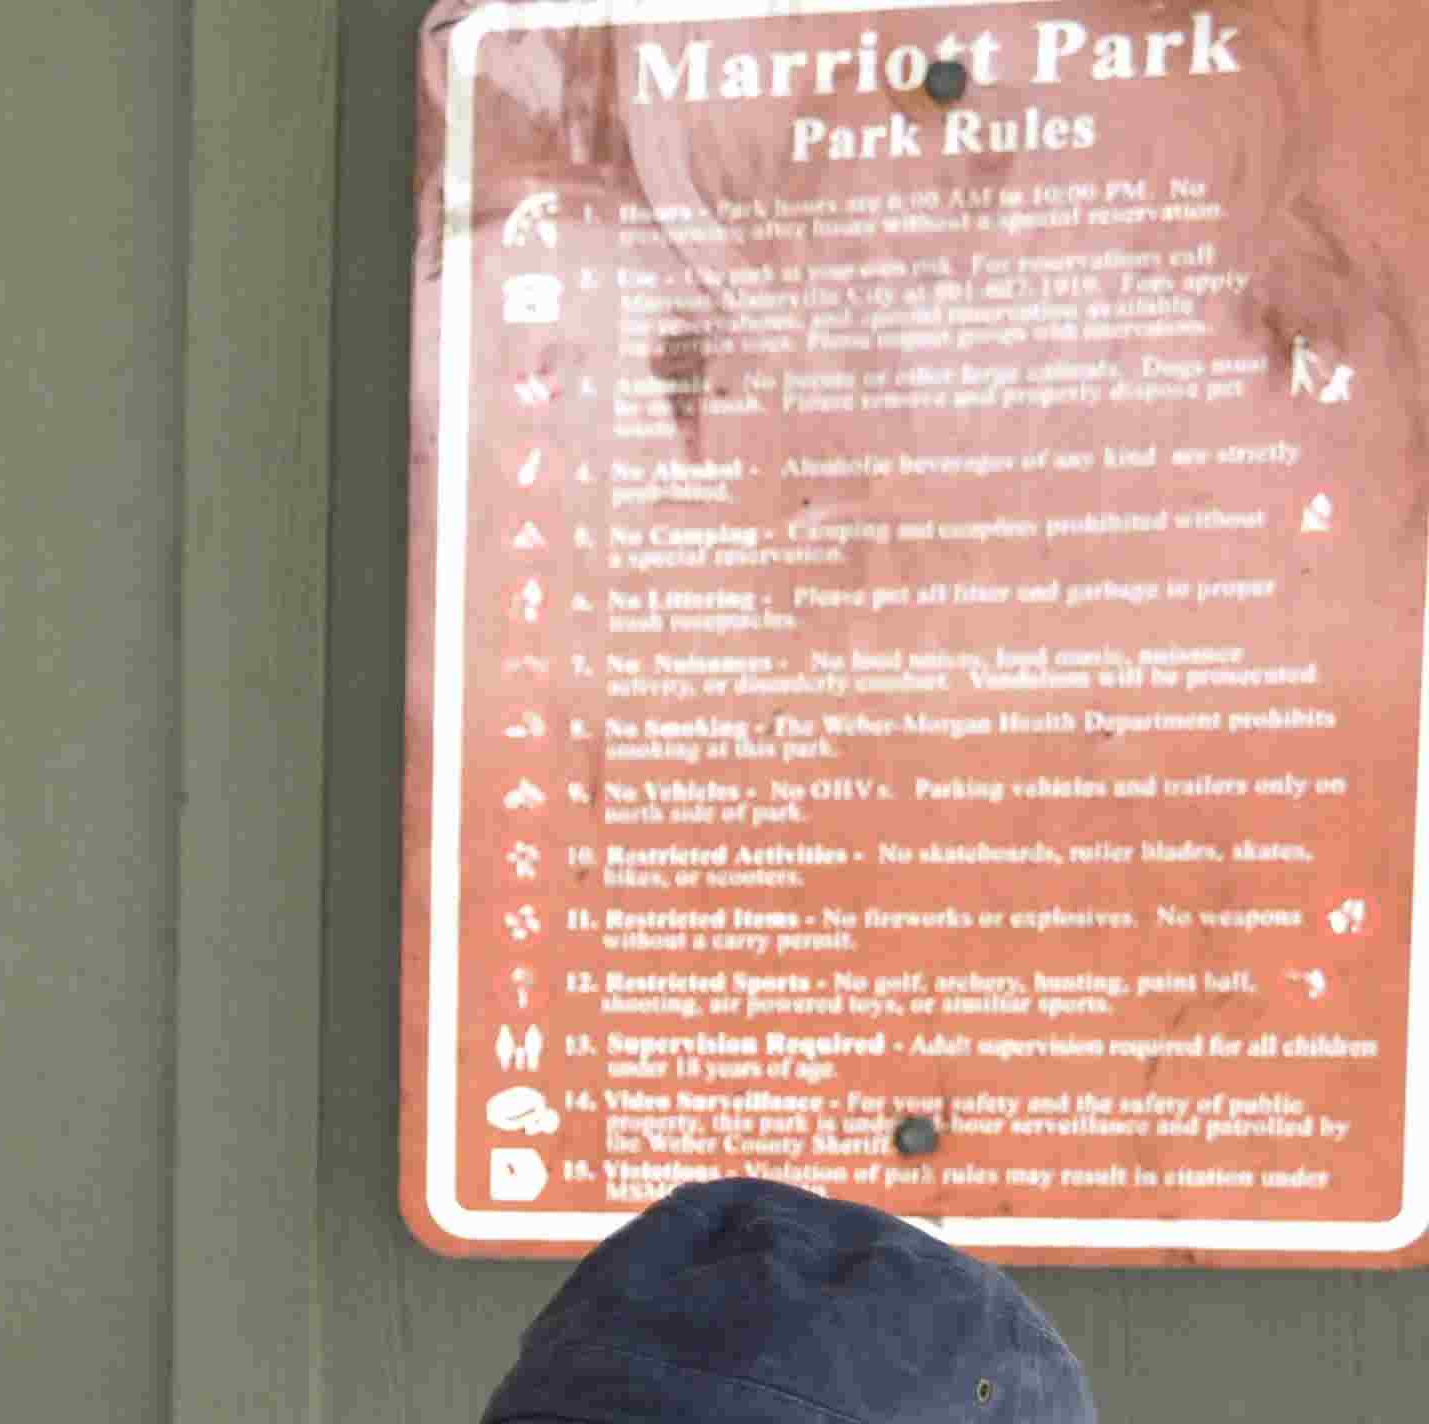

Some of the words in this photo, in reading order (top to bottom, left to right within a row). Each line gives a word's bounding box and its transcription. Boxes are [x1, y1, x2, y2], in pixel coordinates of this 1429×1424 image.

[633, 28, 1003, 104] Marriott
[1029, 12, 1243, 84] Park
[791, 110, 923, 162] Park
[942, 105, 1098, 157] Rules
[610, 462, 644, 481] No
[1103, 441, 1156, 466] kind
[610, 527, 644, 546] No
[648, 523, 757, 548] Camping
[1045, 510, 1168, 536] prohibited
[1173, 508, 1266, 529] without
[607, 589, 641, 610] No
[606, 653, 641, 674] No
[605, 716, 640, 738] No
[644, 715, 748, 745] Smoking
[821, 711, 992, 739] Weber-Morgan
[998, 709, 1078, 734] Health
[1084, 707, 1222, 736] Department
[1227, 705, 1338, 734] prohibits
[604, 780, 640, 802] No
[644, 777, 740, 801] Vehicles
[771, 779, 807, 800] No
[914, 775, 1005, 803] Parking
[1011, 774, 1107, 798] vehicles
[1112, 772, 1158, 796] and
[1163, 772, 1246, 795] trailers
[1252, 771, 1308, 800] only
[1315, 777, 1349, 796] on
[604, 801, 665, 823] north
[668, 800, 717, 823] side
[720, 800, 748, 822] of
[751, 799, 810, 829] park.
[606, 843, 728, 865] Restricted
[734, 841, 848, 864] Activities
[876, 841, 915, 863] No
[918, 839, 1063, 866] skateboards,
[605, 907, 728, 929] Restricted
[732, 907, 800, 929] Items
[822, 907, 859, 929] No
[863, 906, 975, 928] fireworks
[978, 911, 1006, 928] or
[1156, 904, 1195, 927] No
[1198, 909, 1304, 934] weapons
[602, 931, 688, 951] without
[691, 934, 709, 952] a
[711, 935, 770, 958] carry
[776, 931, 858, 957] permit.
[605, 971, 728, 993] Restricted
[731, 971, 812, 999] Sports
[834, 970, 870, 992] No
[872, 969, 928, 996] golf,
[1034, 968, 1132, 996] hunting,
[1137, 969, 1198, 996] paint
[599, 995, 704, 1019] shooting,
[708, 995, 743, 1015] air
[745, 996, 843, 1019] powered
[847, 998, 908, 1020] toys,
[909, 997, 937, 1016] or
[1037, 996, 1116, 1020] sports.
[605, 1032, 758, 1061] Supervision
[764, 1032, 886, 1060] Required
[908, 1032, 972, 1055] Adult
[976, 1033, 1105, 1061] supervision
[1108, 1033, 1205, 1061] required
[1208, 1032, 1244, 1056] for
[1246, 1032, 1279, 1056] all
[1281, 1032, 1380, 1057] children
[607, 1059, 668, 1080] under
[704, 1060, 764, 1083] years
[765, 1057, 794, 1079] of
[603, 1089, 671, 1111] Video
[675, 1089, 823, 1113] Surveillance
[846, 1090, 887, 1112] For
[950, 1092, 1018, 1117] safety
[1026, 1091, 1071, 1113] and
[1075, 1091, 1113, 1113] the
[1118, 1091, 1191, 1118] safety
[1196, 1092, 1228, 1113] of
[1229, 1092, 1304, 1119] public
[712, 1113, 757, 1135] this
[760, 1113, 812, 1138] park
[815, 1112, 838, 1134] is
[1156, 1113, 1200, 1135] and
[1206, 1113, 1314, 1141] patrolled
[1319, 1113, 1352, 1140] by
[606, 1134, 644, 1155] the
[648, 1136, 719, 1155] Weber
[722, 1136, 805, 1159] County
[603, 1159, 720, 1182] Violations
[852, 1162, 882, 1185] of
[942, 1162, 998, 1185] rules
[1005, 1167, 1052, 1190] may
[1060, 1163, 1127, 1186] result
[1133, 1163, 1159, 1186] in
[1162, 1164, 1254, 1187] citation
[1260, 1165, 1331, 1188] under
